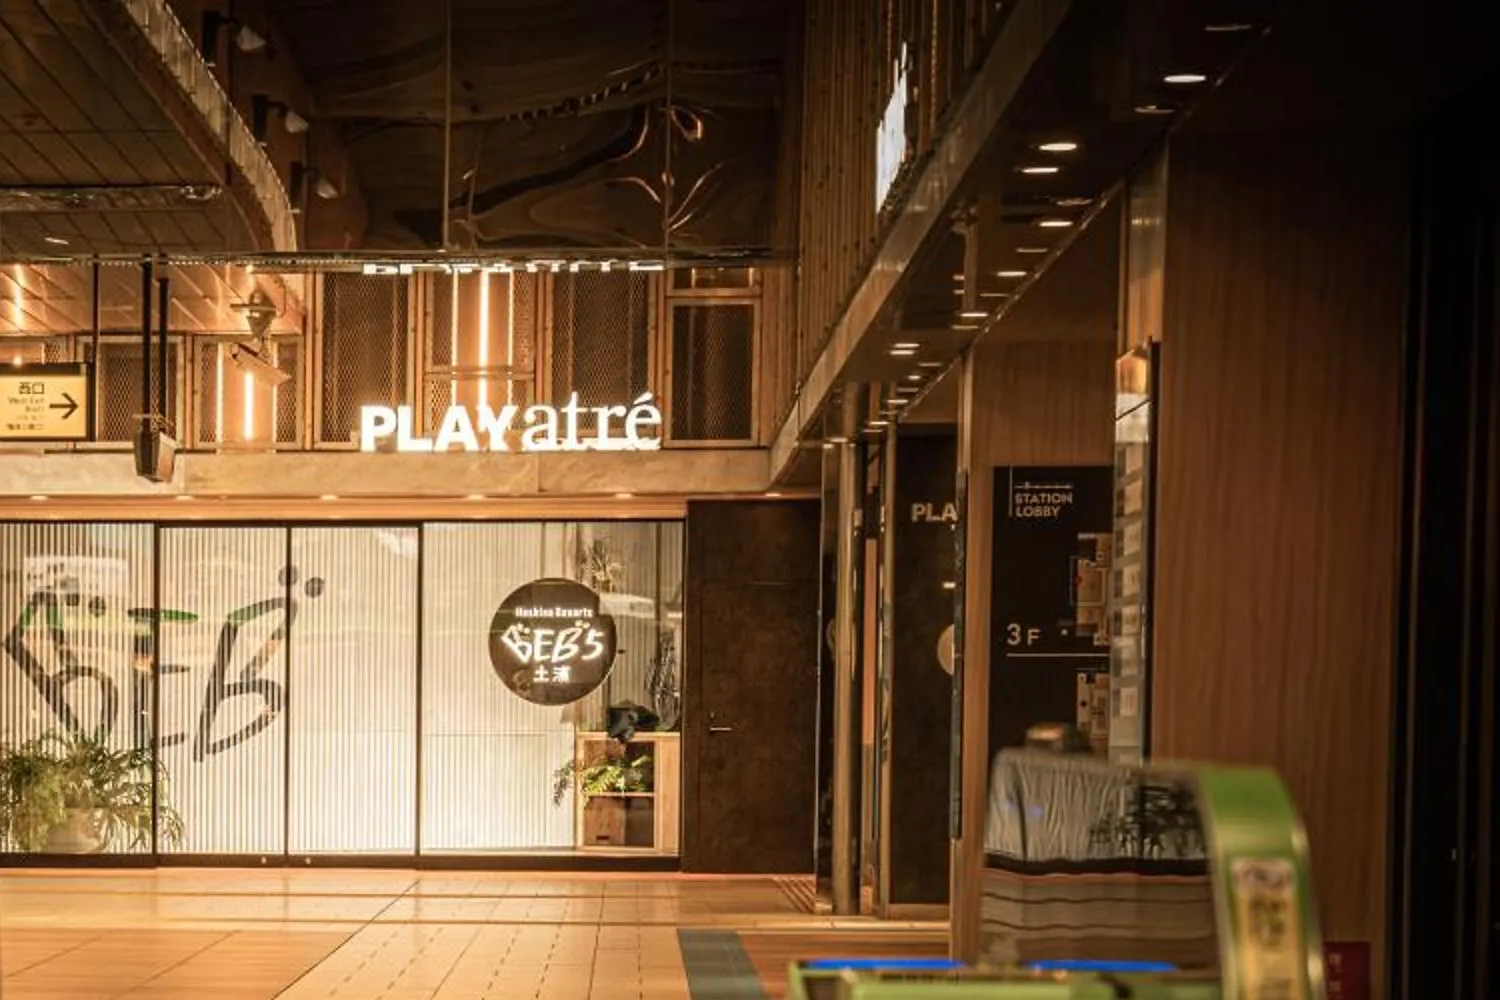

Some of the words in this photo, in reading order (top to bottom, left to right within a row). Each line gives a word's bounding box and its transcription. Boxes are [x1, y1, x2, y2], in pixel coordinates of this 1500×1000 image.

[19, 382, 45, 395] 西口
[1015, 493, 1073, 504] STATION
[1015, 505, 1061, 518] LOBBY
[533, 665, 571, 683] 土浦
